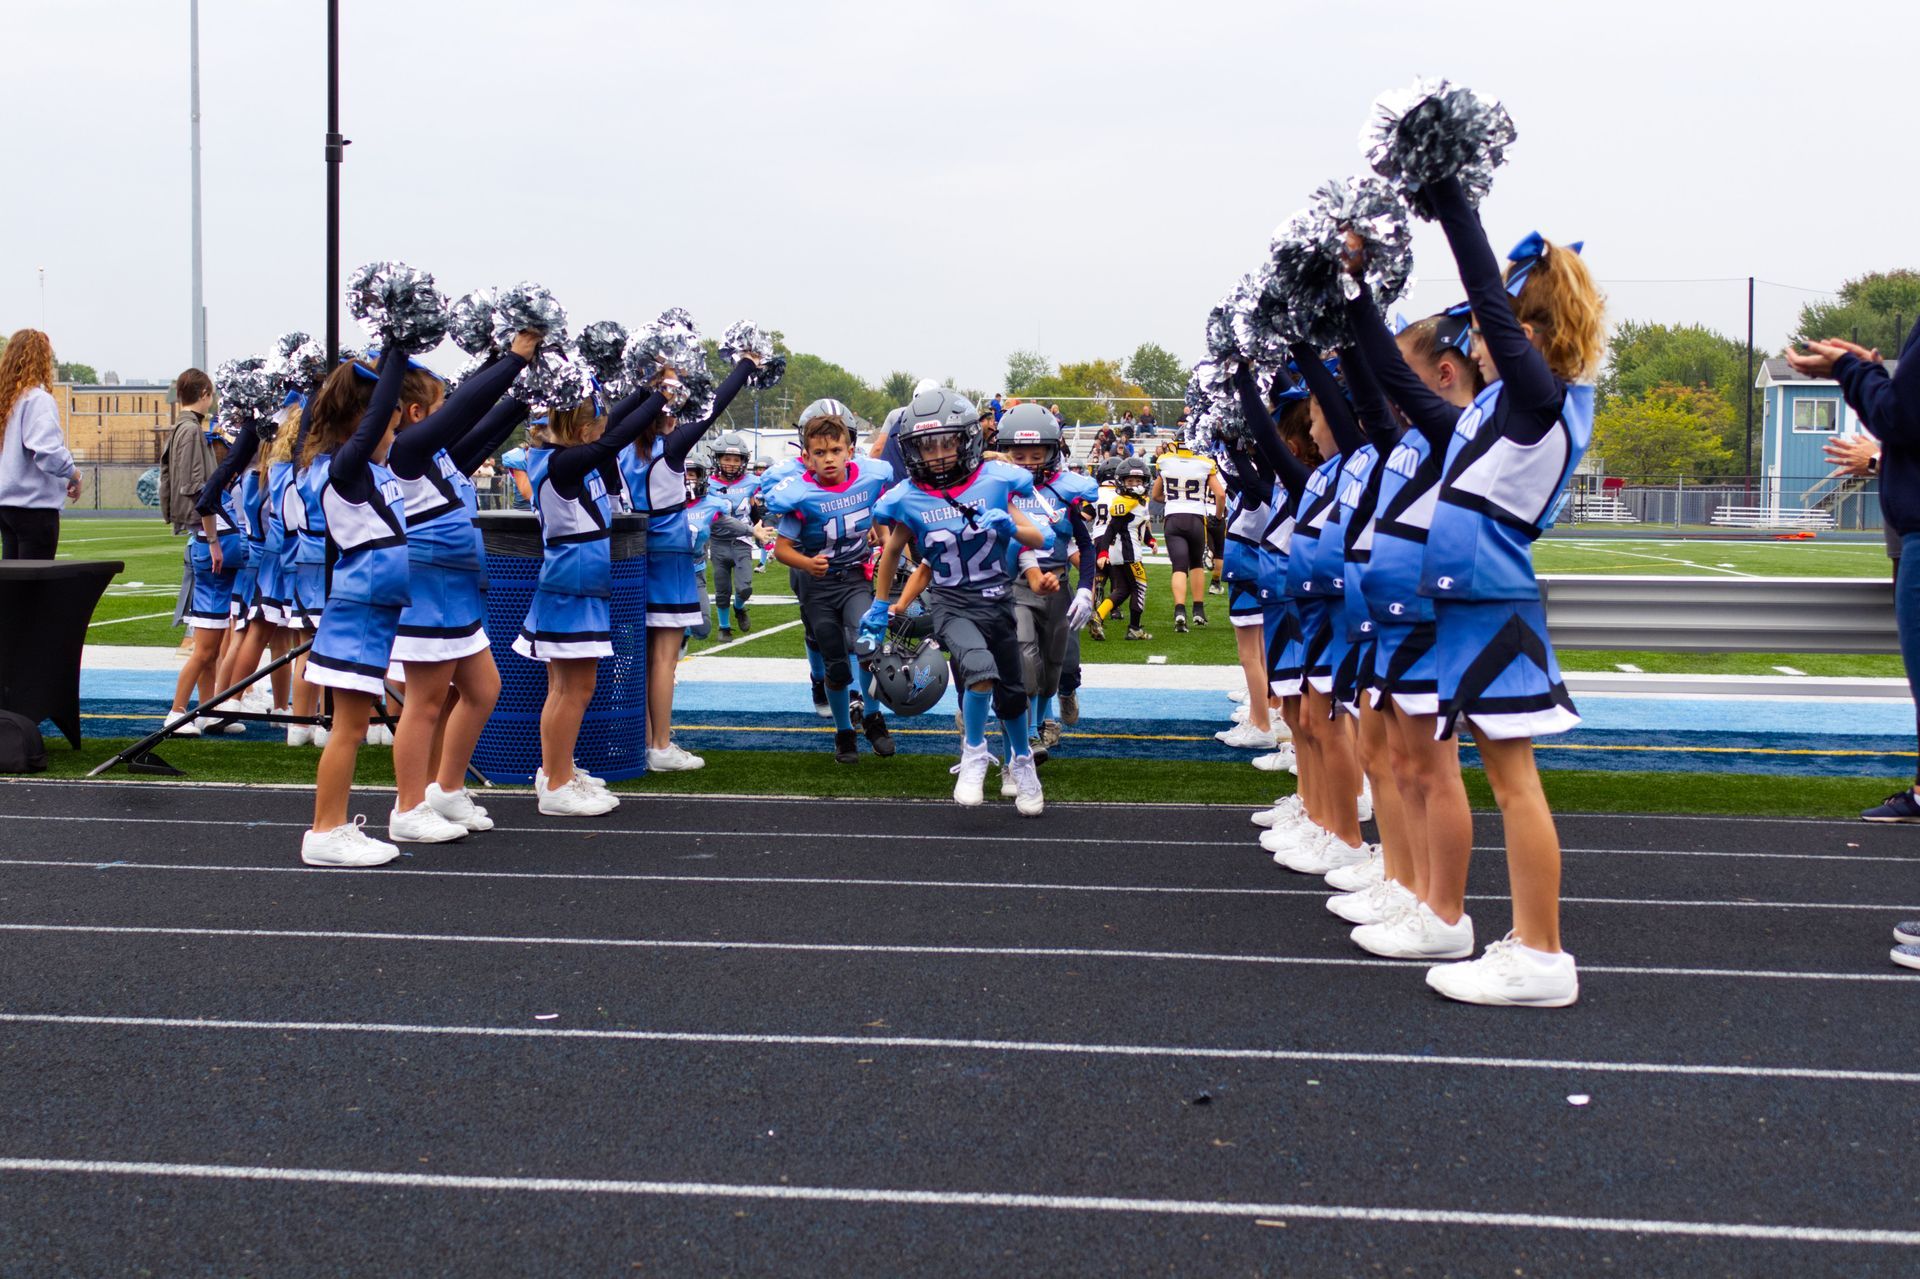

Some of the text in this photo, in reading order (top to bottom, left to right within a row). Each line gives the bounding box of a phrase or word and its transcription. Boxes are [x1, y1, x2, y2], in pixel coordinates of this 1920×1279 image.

[820, 490, 869, 513] RICHMOND
[1165, 477, 1200, 501] 52
[921, 498, 986, 524] RICHD
[1114, 503, 1125, 515] 10
[820, 507, 870, 558] 15
[924, 522, 1002, 587] 32
